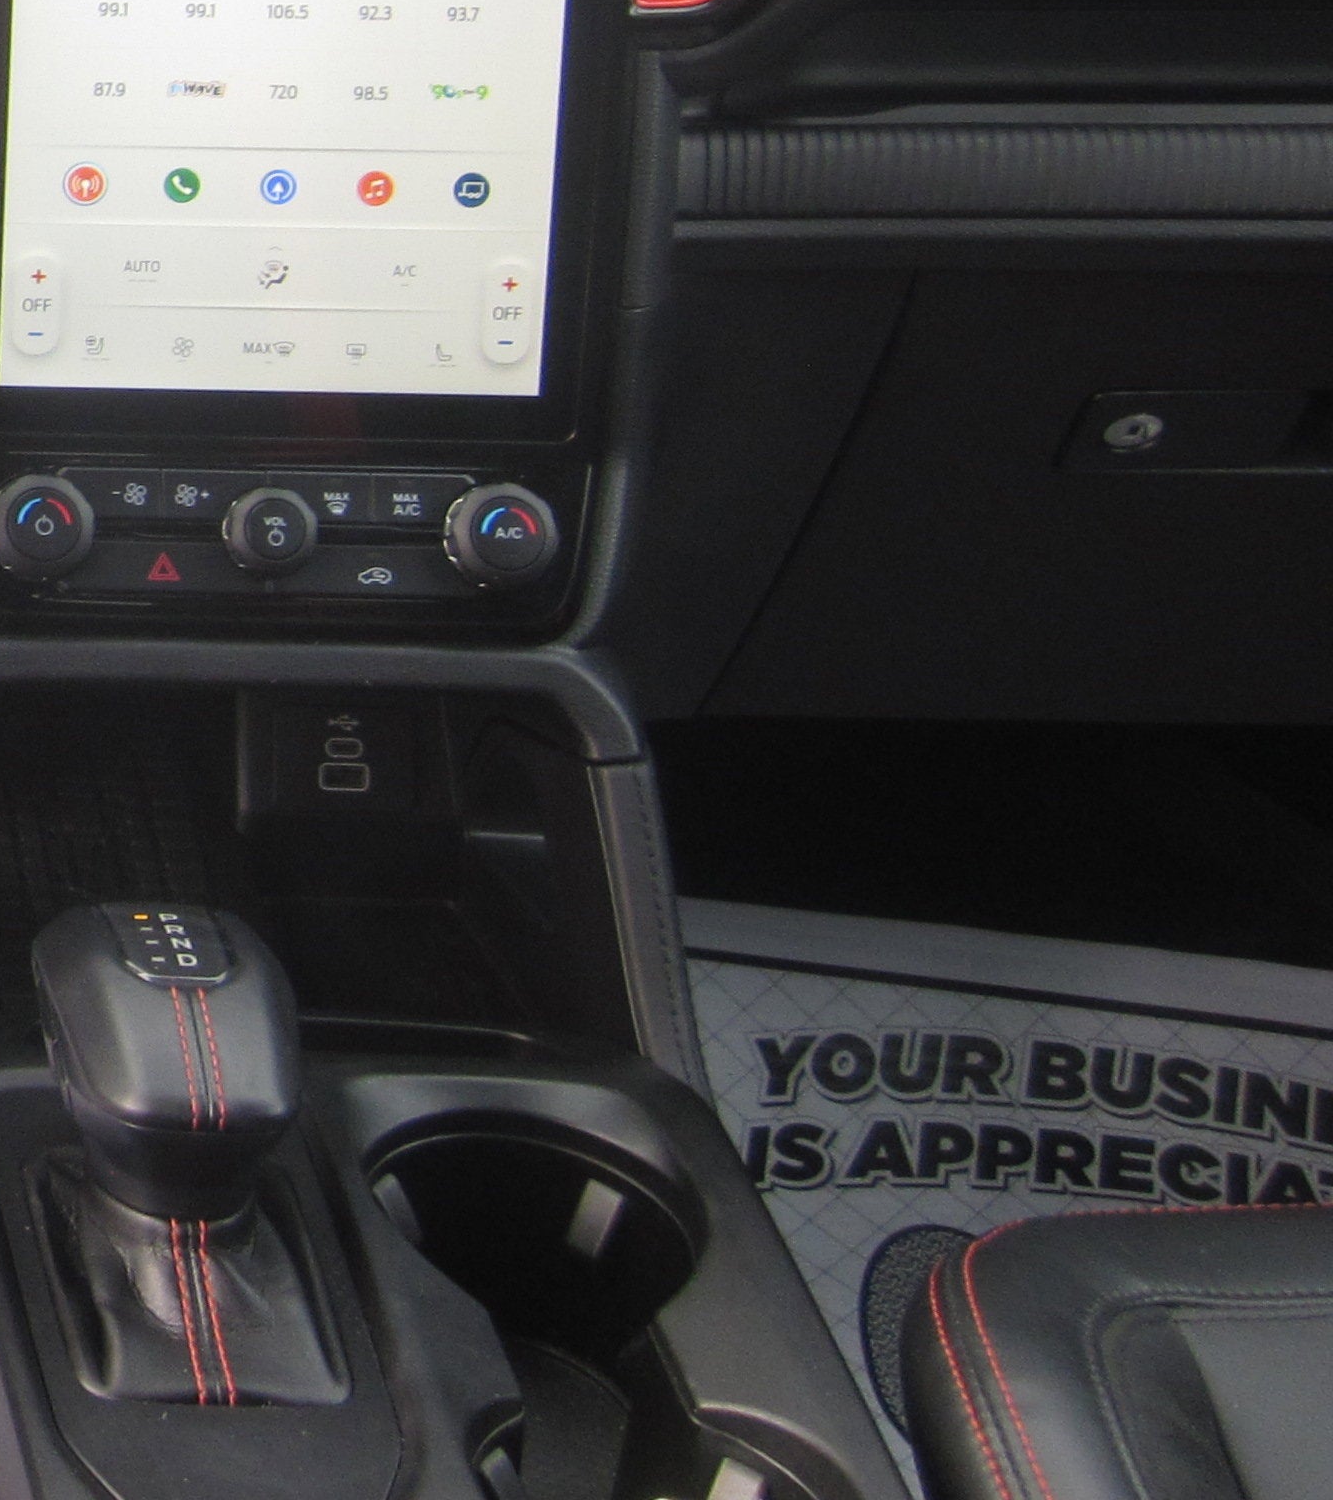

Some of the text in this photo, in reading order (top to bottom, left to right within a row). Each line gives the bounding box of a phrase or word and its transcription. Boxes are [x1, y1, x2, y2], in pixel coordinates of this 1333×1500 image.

[98, 2, 130, 17] 99.1
[185, 3, 217, 18] 99.1
[267, 4, 310, 20] 106.5
[358, 5, 393, 21] 92.3
[447, 6, 480, 22] 93.7
[93, 81, 127, 97] 87.9
[269, 84, 299, 100] 720
[353, 86, 389, 101] 98.5
[123, 260, 162, 274] AUTO
[392, 263, 417, 279] A/C
[21, 297, 52, 313] OFF
[492, 305, 523, 322] OFF
[243, 341, 272, 356] MAX
[323, 491, 351, 503] MAX
[392, 493, 420, 503] MAX
[392, 503, 422, 517] A/C
[263, 516, 288, 527] VOL
[495, 526, 524, 540] A/C
[158, 913, 179, 923] P
[165, 924, 185, 935] R
[171, 937, 193, 950] N
[176, 953, 198, 967] D
[755, 1032, 1009, 1100] YOUR
[846, 1120, 1333, 1206] APPRECIA
